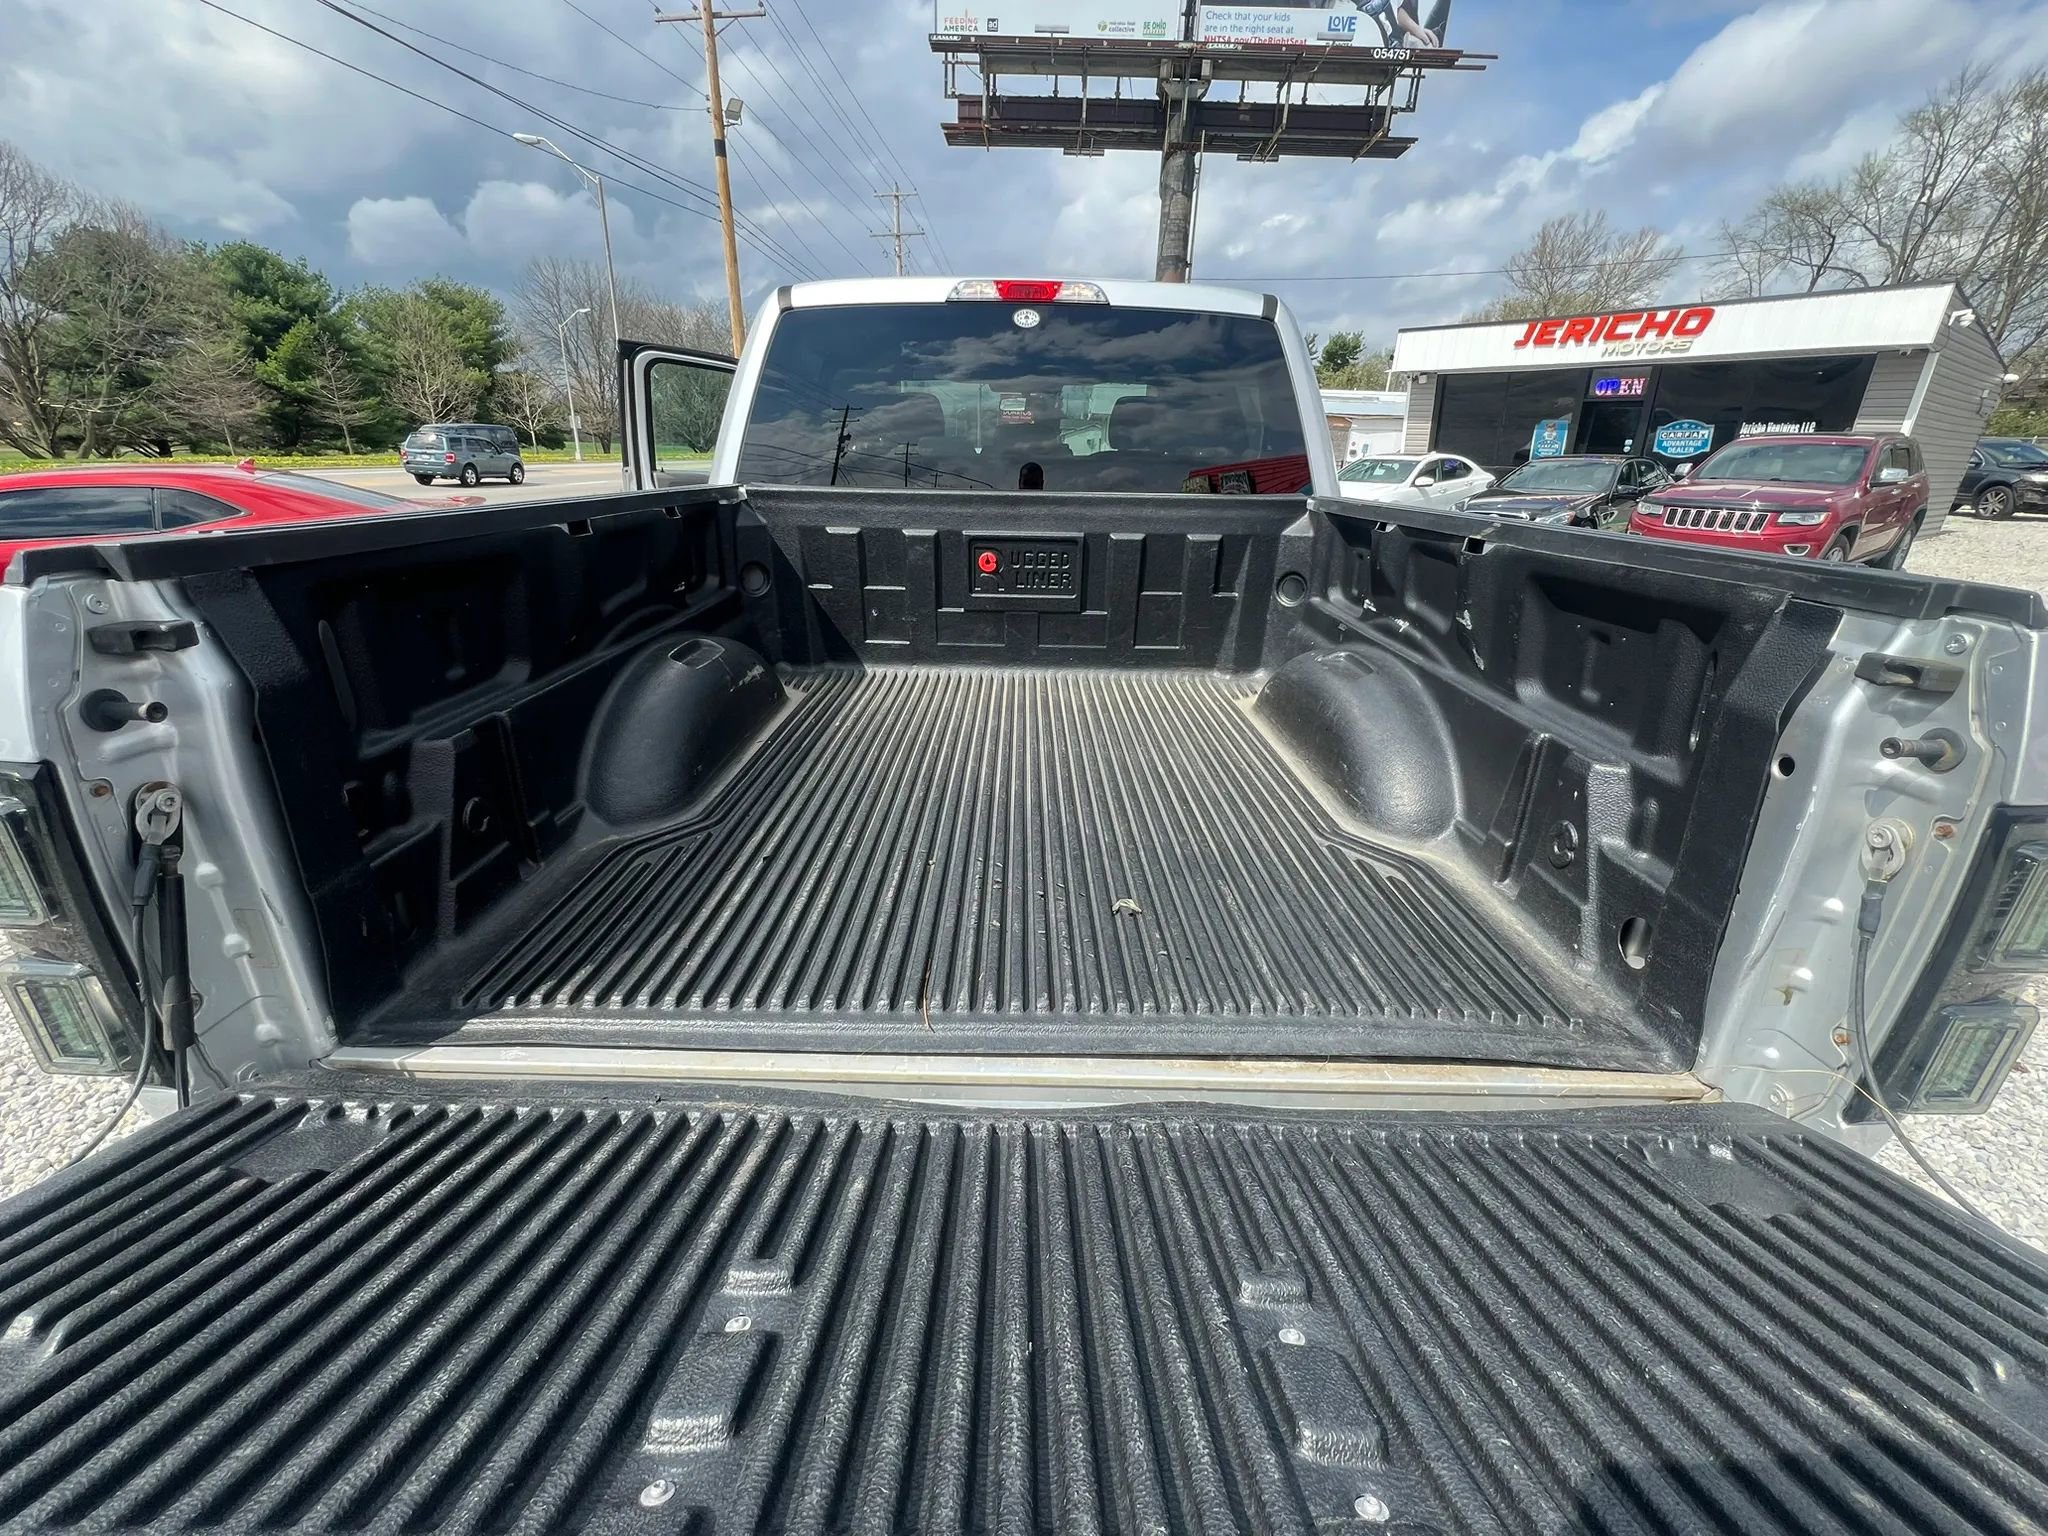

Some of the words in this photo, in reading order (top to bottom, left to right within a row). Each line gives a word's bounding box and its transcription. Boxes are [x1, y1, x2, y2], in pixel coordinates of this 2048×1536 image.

[1205, 11, 1232, 20] Check
[1235, 12, 1251, 20] that
[1253, 14, 1272, 23] your
[1274, 13, 1291, 21] kids
[1143, 21, 1151, 30] SE
[1220, 24, 1228, 32] in
[1230, 24, 1244, 32] the
[1245, 25, 1265, 35] right
[1267, 26, 1284, 34] seat
[1286, 26, 1294, 34] at
[1328, 15, 1357, 32] LOVE
[1373, 48, 1411, 60] 054751
[1513, 306, 1716, 348] JERICHO
[1601, 338, 1694, 358] MOTORS
[1595, 378, 1646, 396] OPEN
[1767, 422, 1800, 433] Ventures
[1800, 421, 1816, 433] LLC
[1661, 431, 1708, 439] CARFAX
[1015, 572, 1072, 589] LINER
